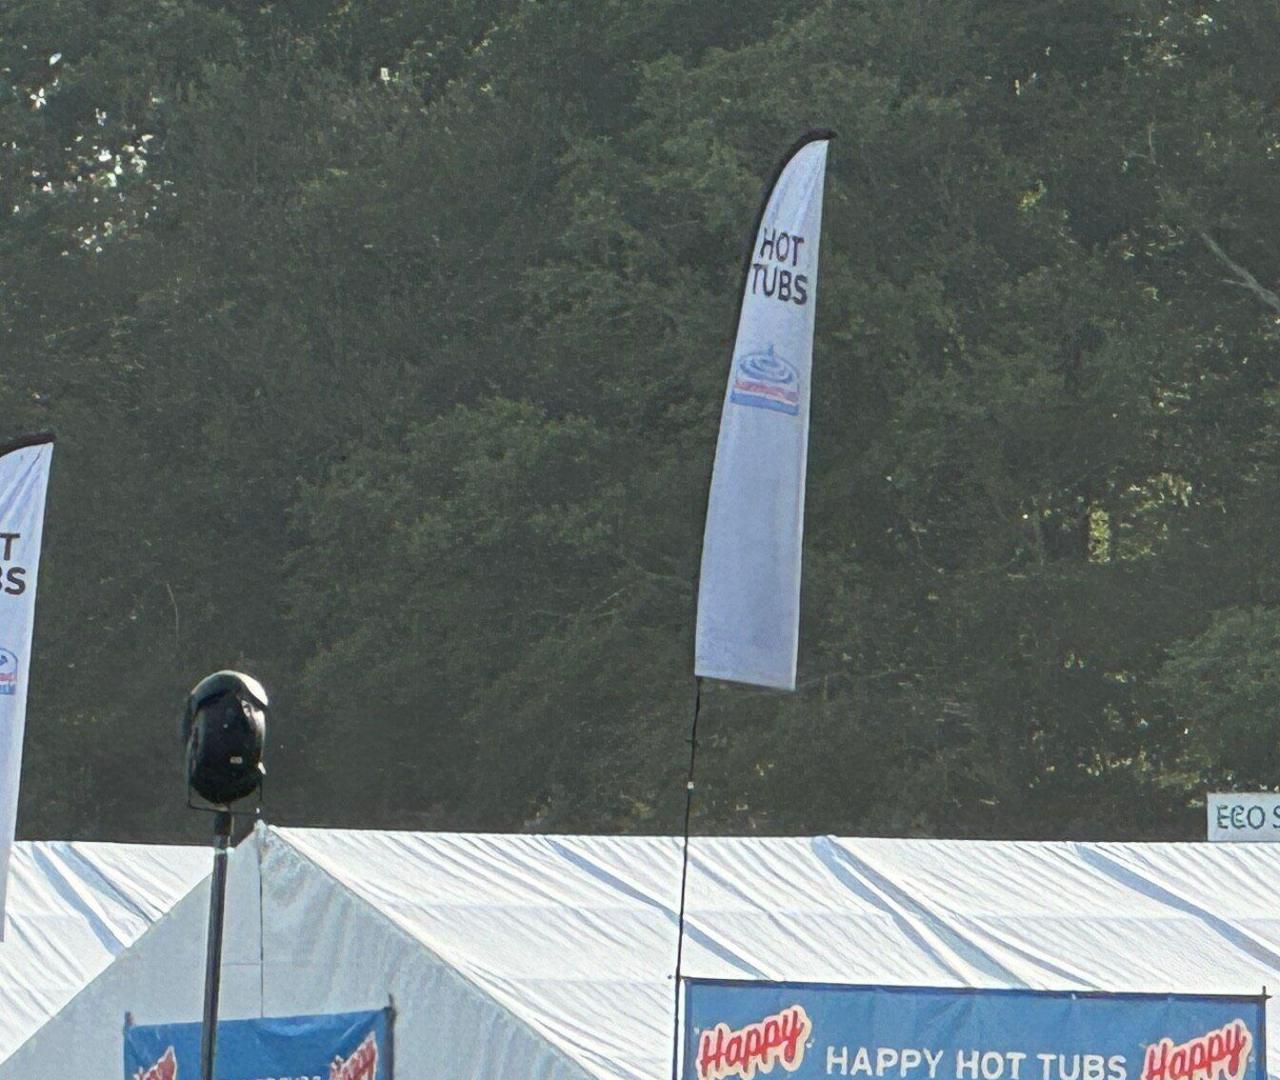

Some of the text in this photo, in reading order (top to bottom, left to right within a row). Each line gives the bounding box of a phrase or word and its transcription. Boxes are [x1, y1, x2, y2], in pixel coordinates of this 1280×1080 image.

[760, 229, 804, 267] HOT
[752, 264, 808, 305] TUBS
[1216, 805, 1266, 830] ECO
[698, 1008, 807, 1080] Happy
[826, 1046, 943, 1078] HAPPY
[955, 1049, 1026, 1080] HOT
